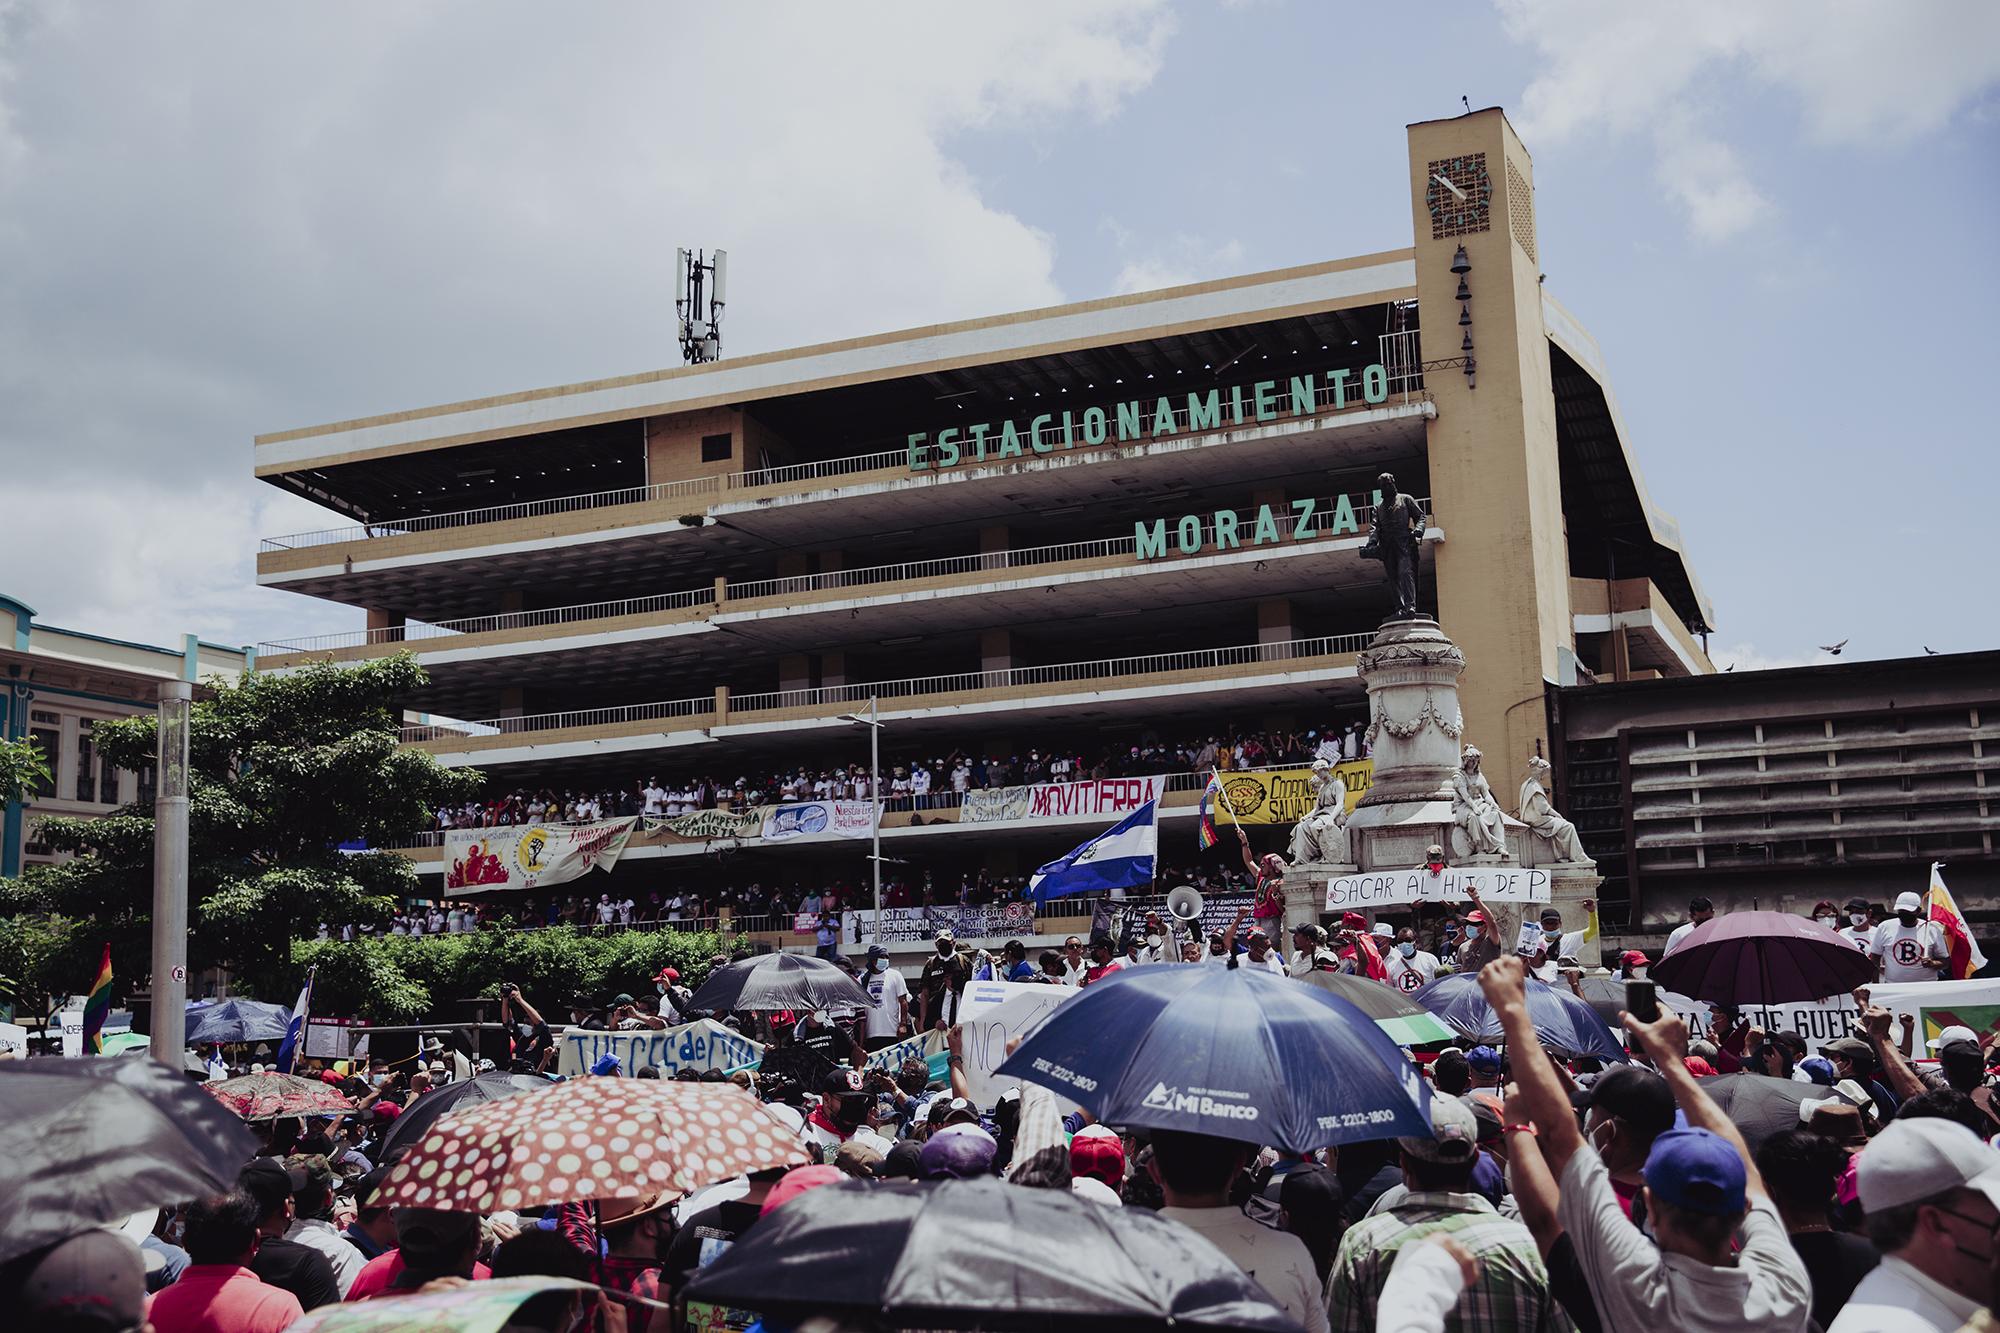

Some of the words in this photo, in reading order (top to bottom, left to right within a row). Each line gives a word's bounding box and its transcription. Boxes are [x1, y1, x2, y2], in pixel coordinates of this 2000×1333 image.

[908, 364, 1388, 471] ESTACIONAMIENTO
[1135, 489, 1382, 560] MORAZA
[1230, 787, 1253, 798] CSS
[1333, 877, 1395, 904] SACAR
[1407, 875, 1429, 896] AL
[1496, 874, 1519, 893] DE
[965, 905, 1004, 918] Bitcoin
[861, 919, 930, 934] INDPENDENCIA
[679, 1030, 706, 1060] de
[968, 1021, 1006, 1072] NO
[1051, 1065, 1098, 1092] 2212-1800
[1200, 1097, 1259, 1120] Banco
[1341, 1109, 1395, 1127] 2212-1800
